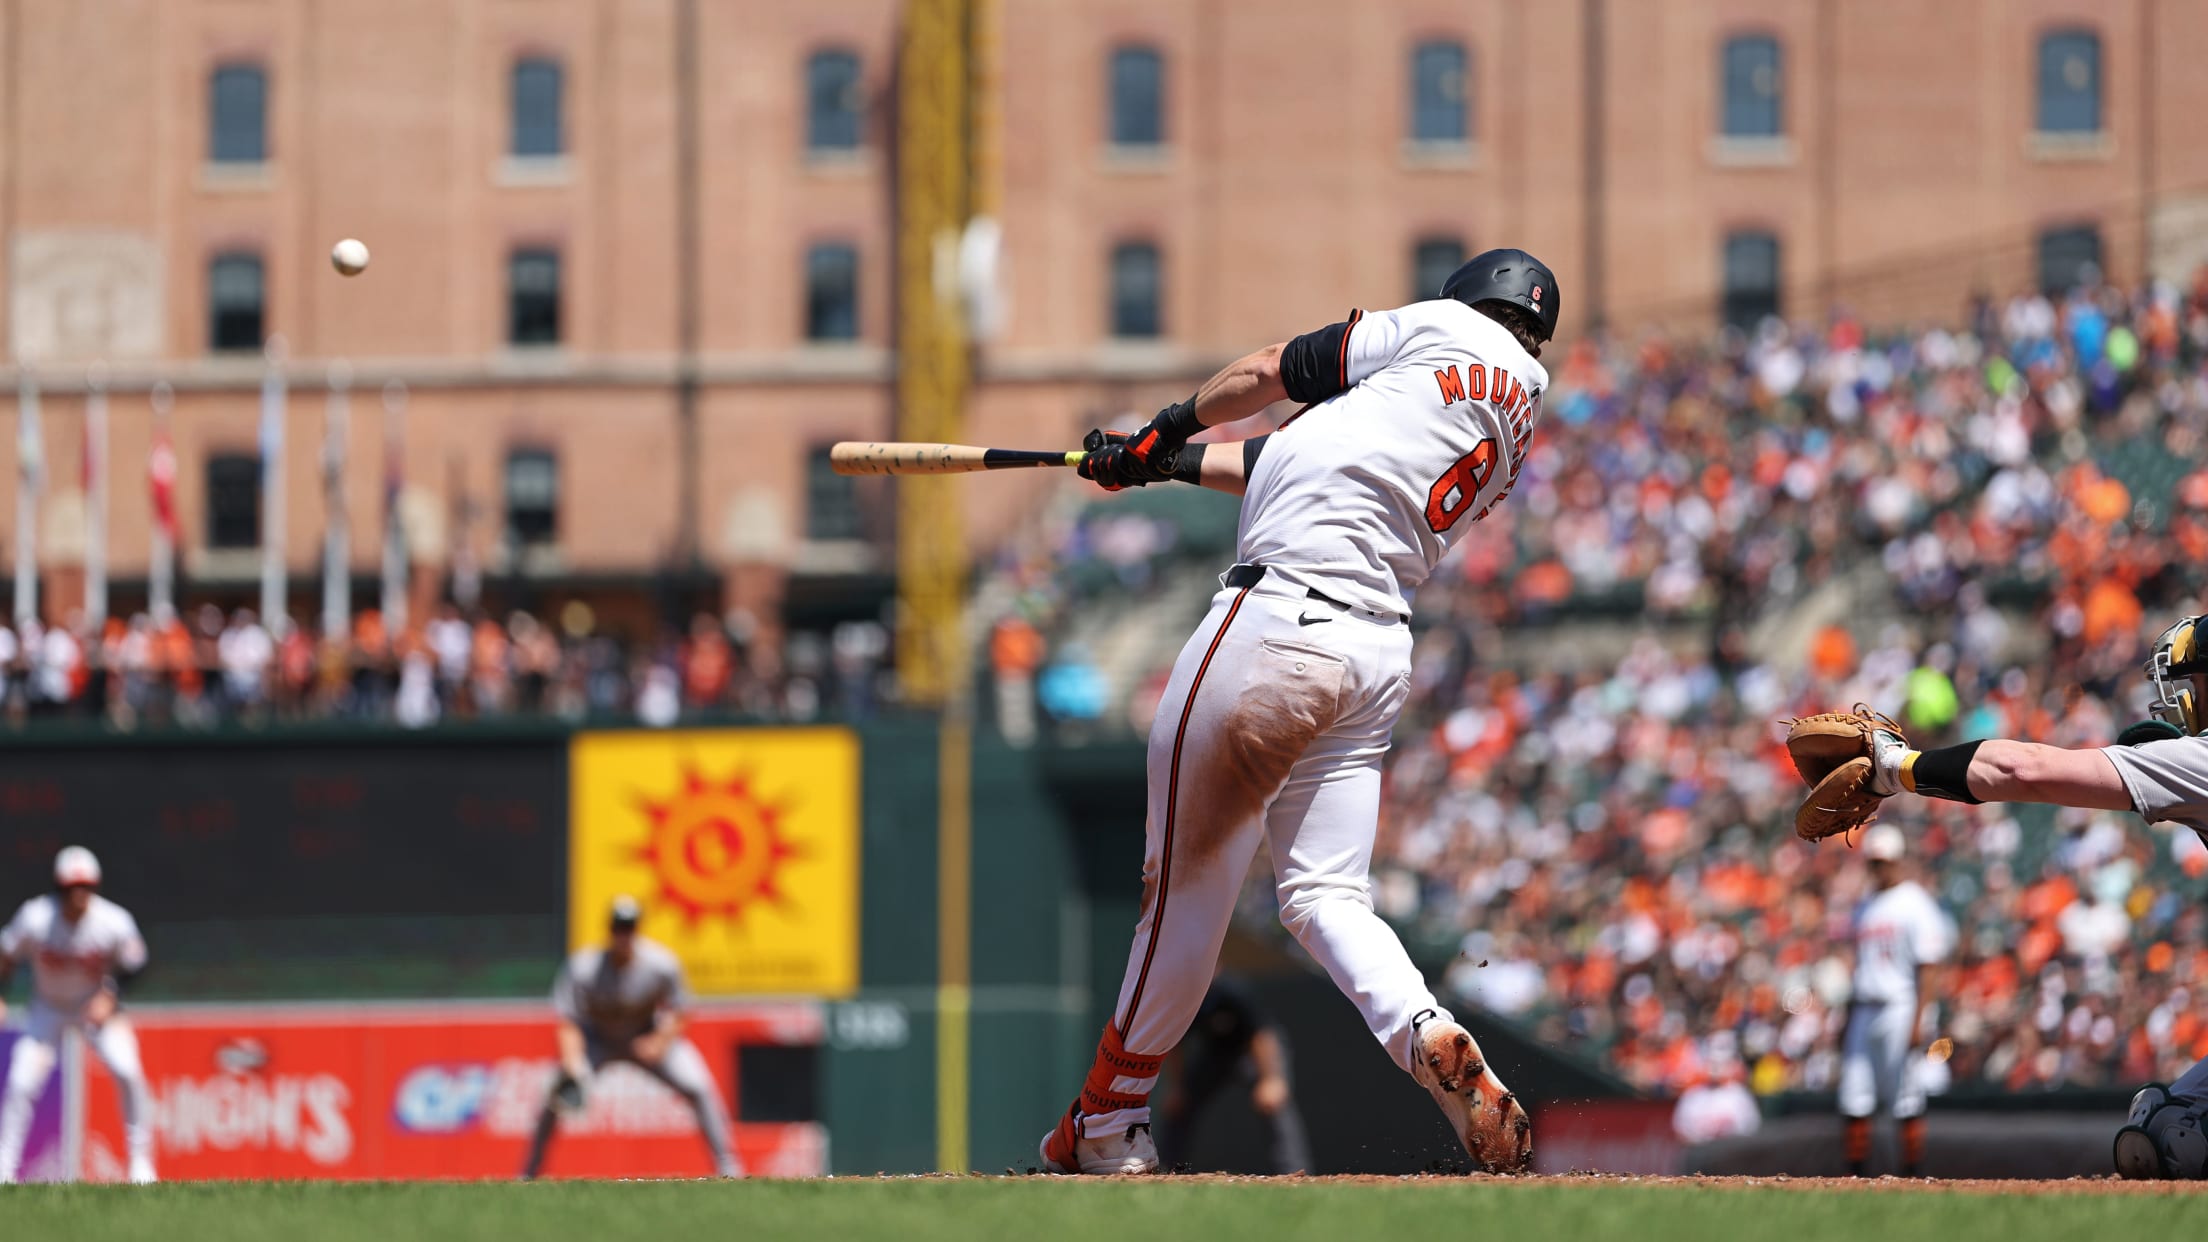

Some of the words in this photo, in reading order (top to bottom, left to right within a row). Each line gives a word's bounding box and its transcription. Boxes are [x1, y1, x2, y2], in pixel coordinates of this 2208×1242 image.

[1532, 285, 1542, 301] 6
[1424, 438, 1498, 534] 6
[1434, 363, 1534, 522] MOUNTCAS
